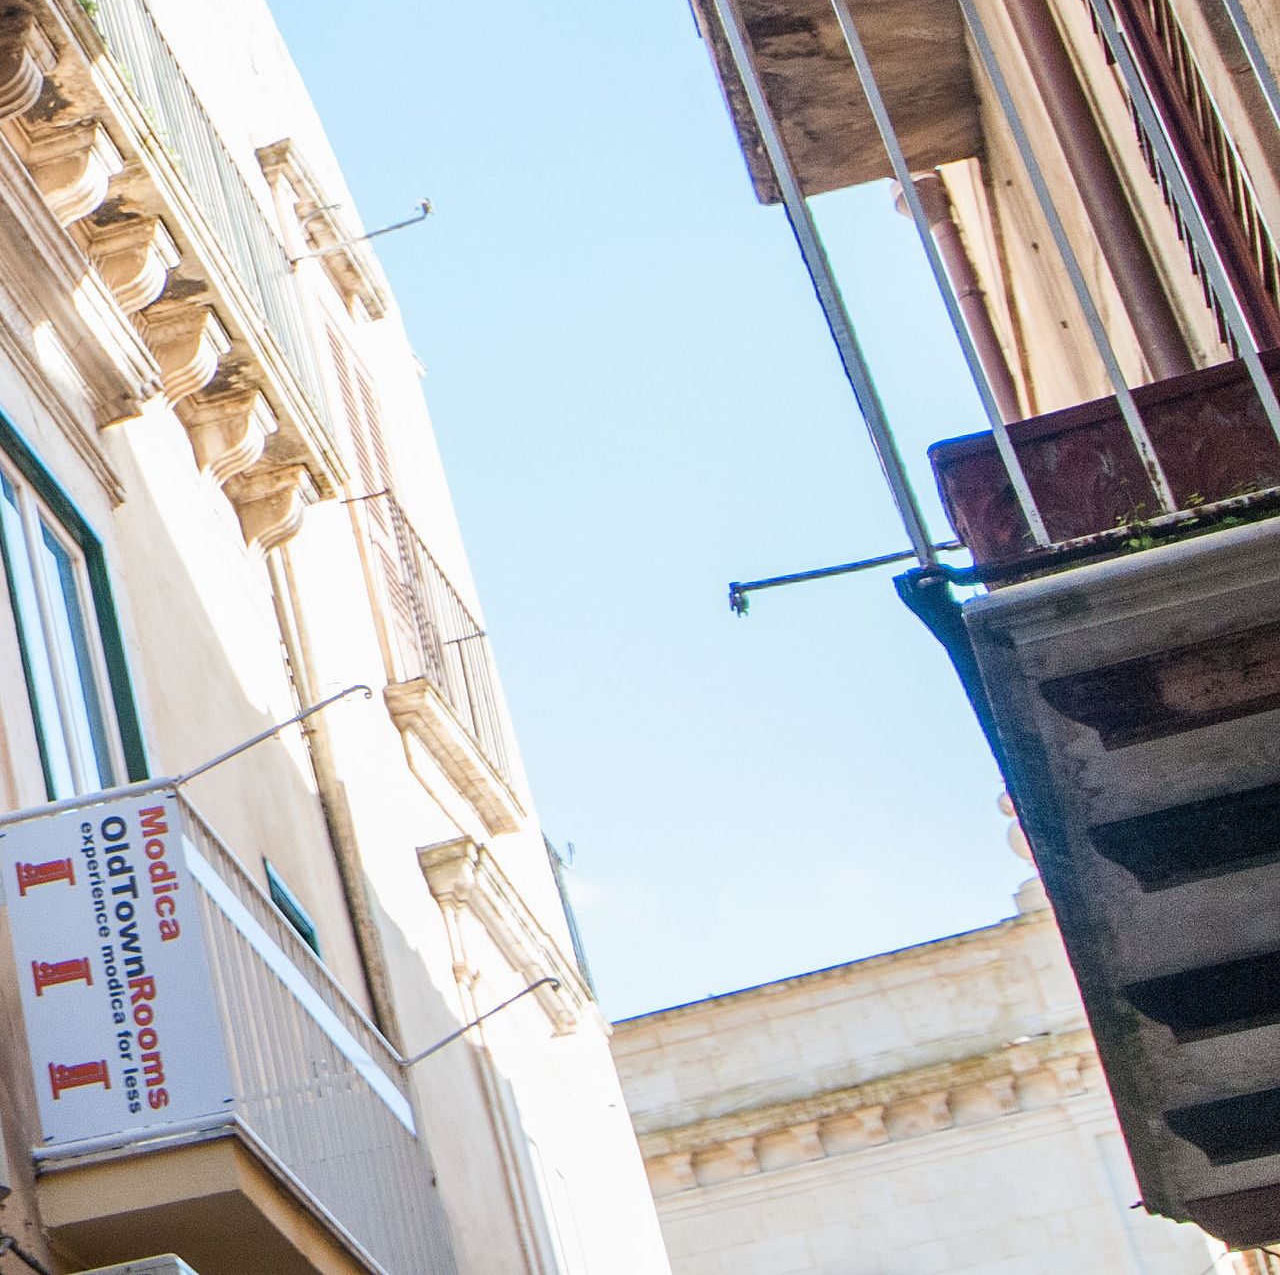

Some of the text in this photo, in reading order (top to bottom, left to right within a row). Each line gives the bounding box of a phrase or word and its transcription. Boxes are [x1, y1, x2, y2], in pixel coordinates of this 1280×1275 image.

[80, 821, 142, 1114] experience modica for less
[100, 815, 170, 1110] OldTownRooms
[138, 805, 181, 942] Modica
